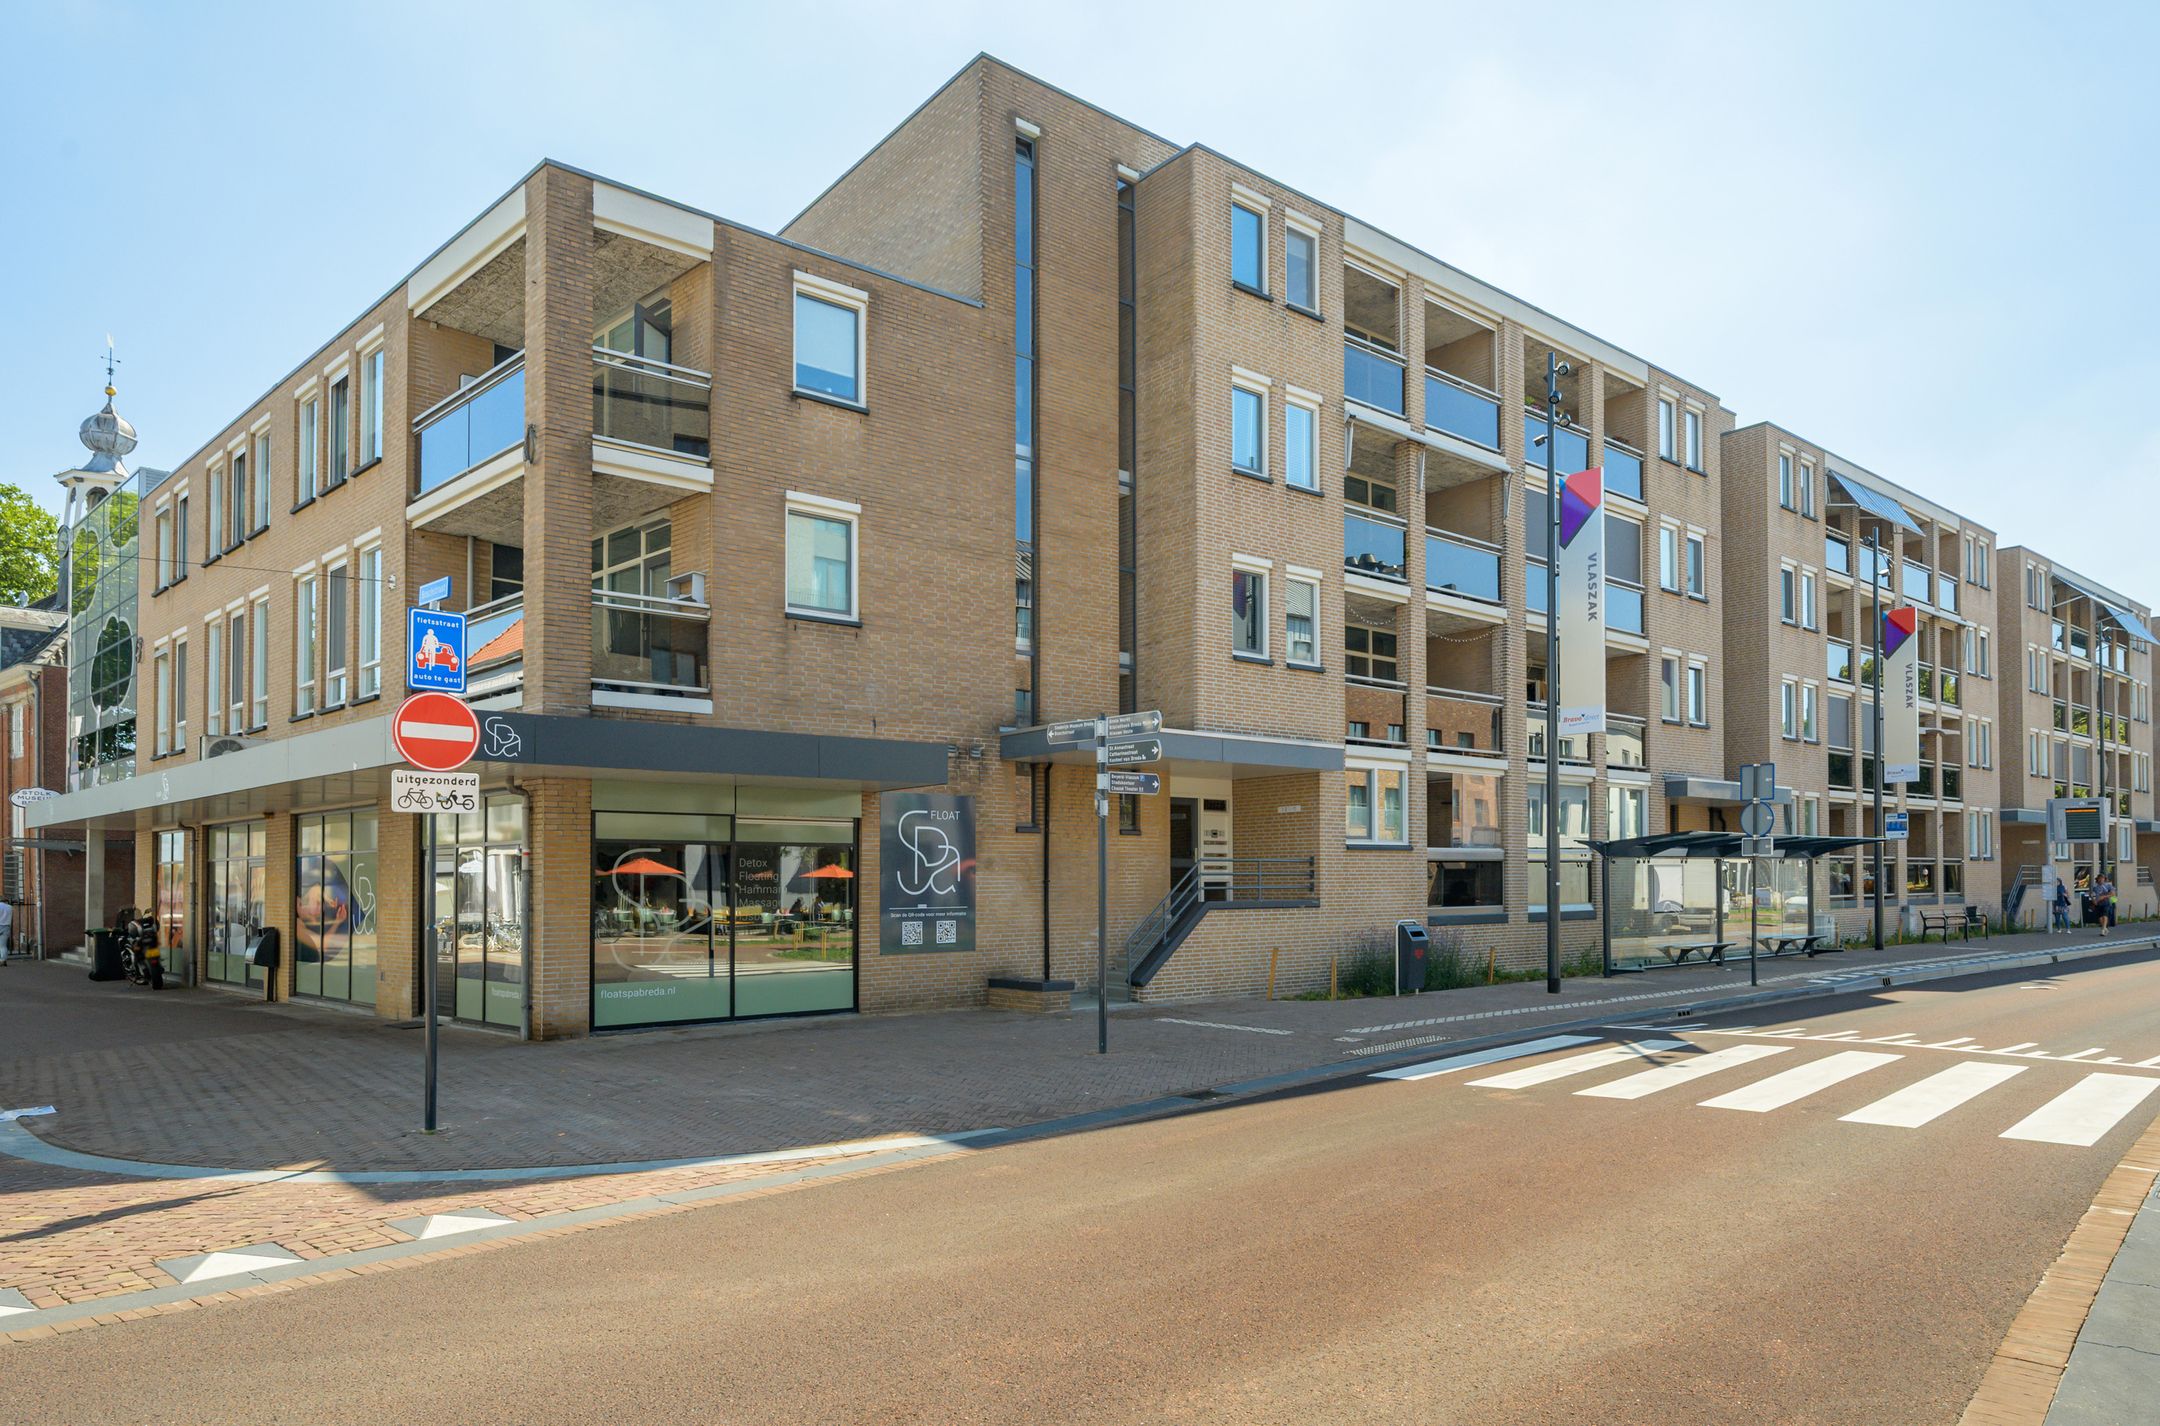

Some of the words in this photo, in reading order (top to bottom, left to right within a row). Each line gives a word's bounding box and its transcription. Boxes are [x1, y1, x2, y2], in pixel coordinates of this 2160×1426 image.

[1587, 552, 1598, 622] VLASZAK
[416, 616, 460, 629] fietsstraat
[413, 673, 432, 681] auto
[444, 676, 461, 684] gast
[1905, 663, 1914, 709] VLASZAK
[396, 774, 477, 787] uitgezonderd
[930, 810, 960, 821] FLOAT
[739, 858, 768, 868] Detox
[739, 871, 779, 883] Floating
[600, 986, 677, 999] floatspabreda.nl
